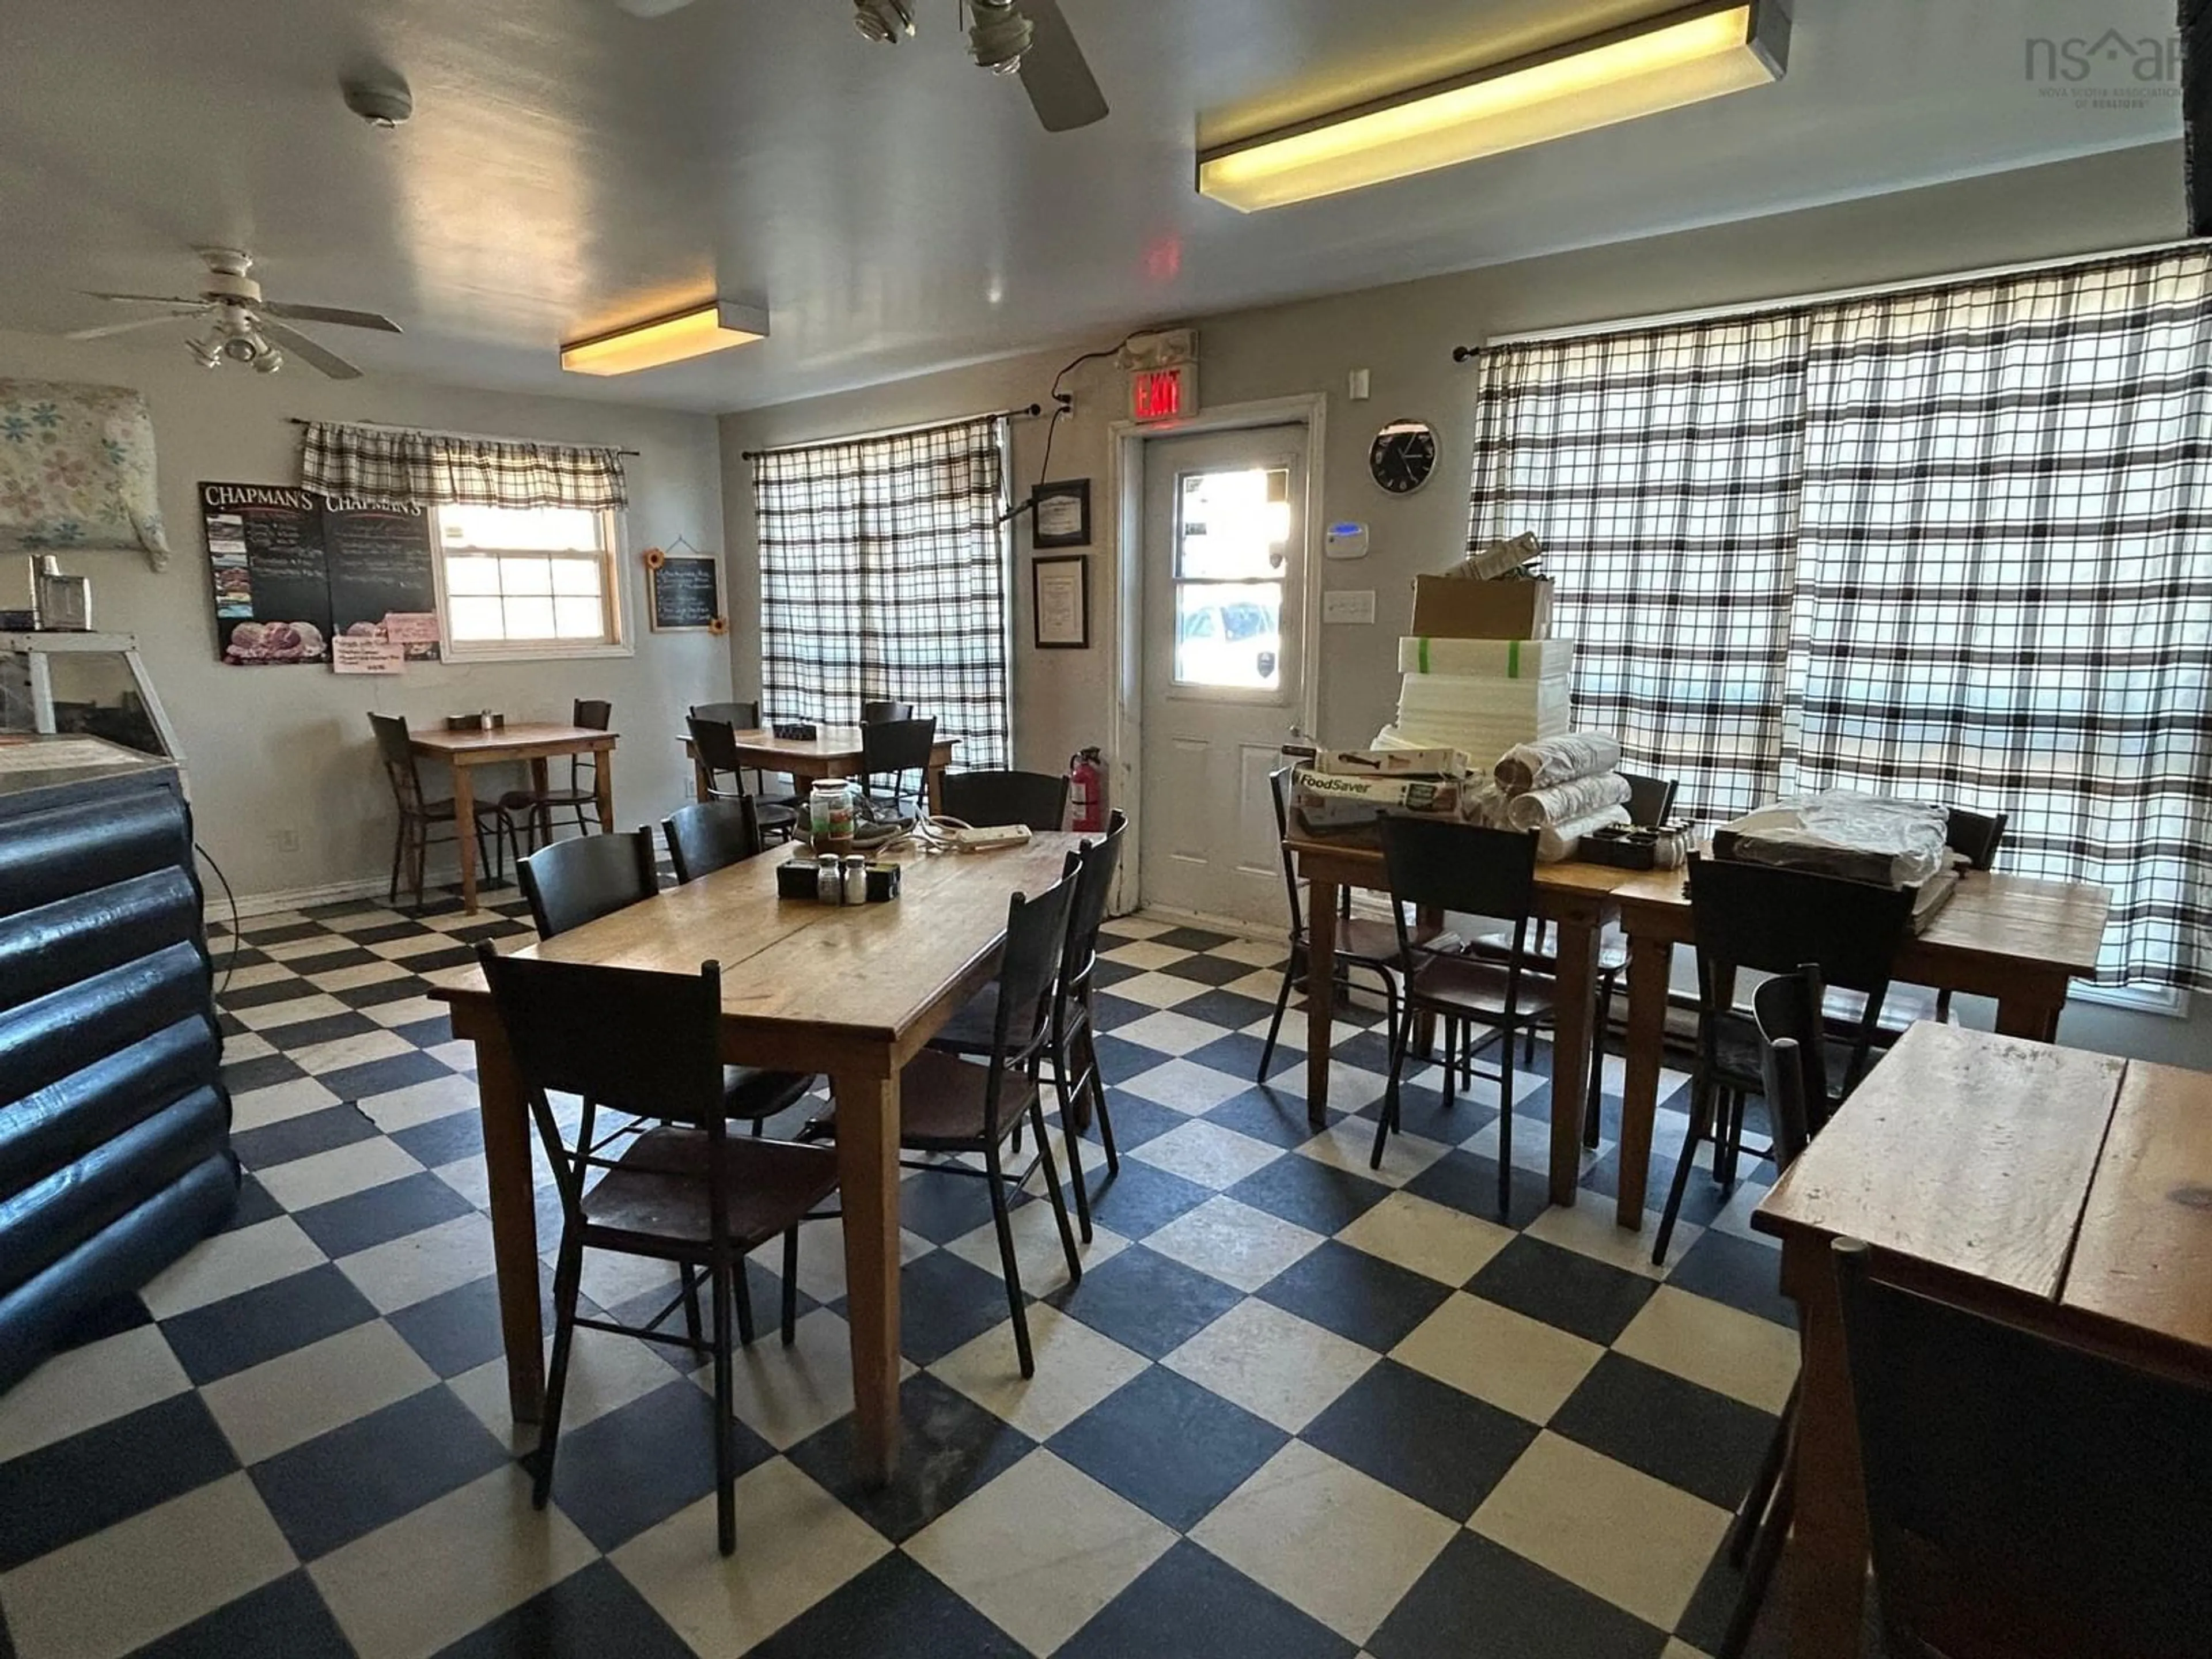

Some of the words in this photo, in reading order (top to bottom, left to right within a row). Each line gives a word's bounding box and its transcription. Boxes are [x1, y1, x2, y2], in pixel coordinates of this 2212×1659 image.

[1137, 372, 1178, 418] EXIT
[205, 486, 313, 510] CHAPMAN'S
[1301, 774, 1372, 793] FoodSaver
